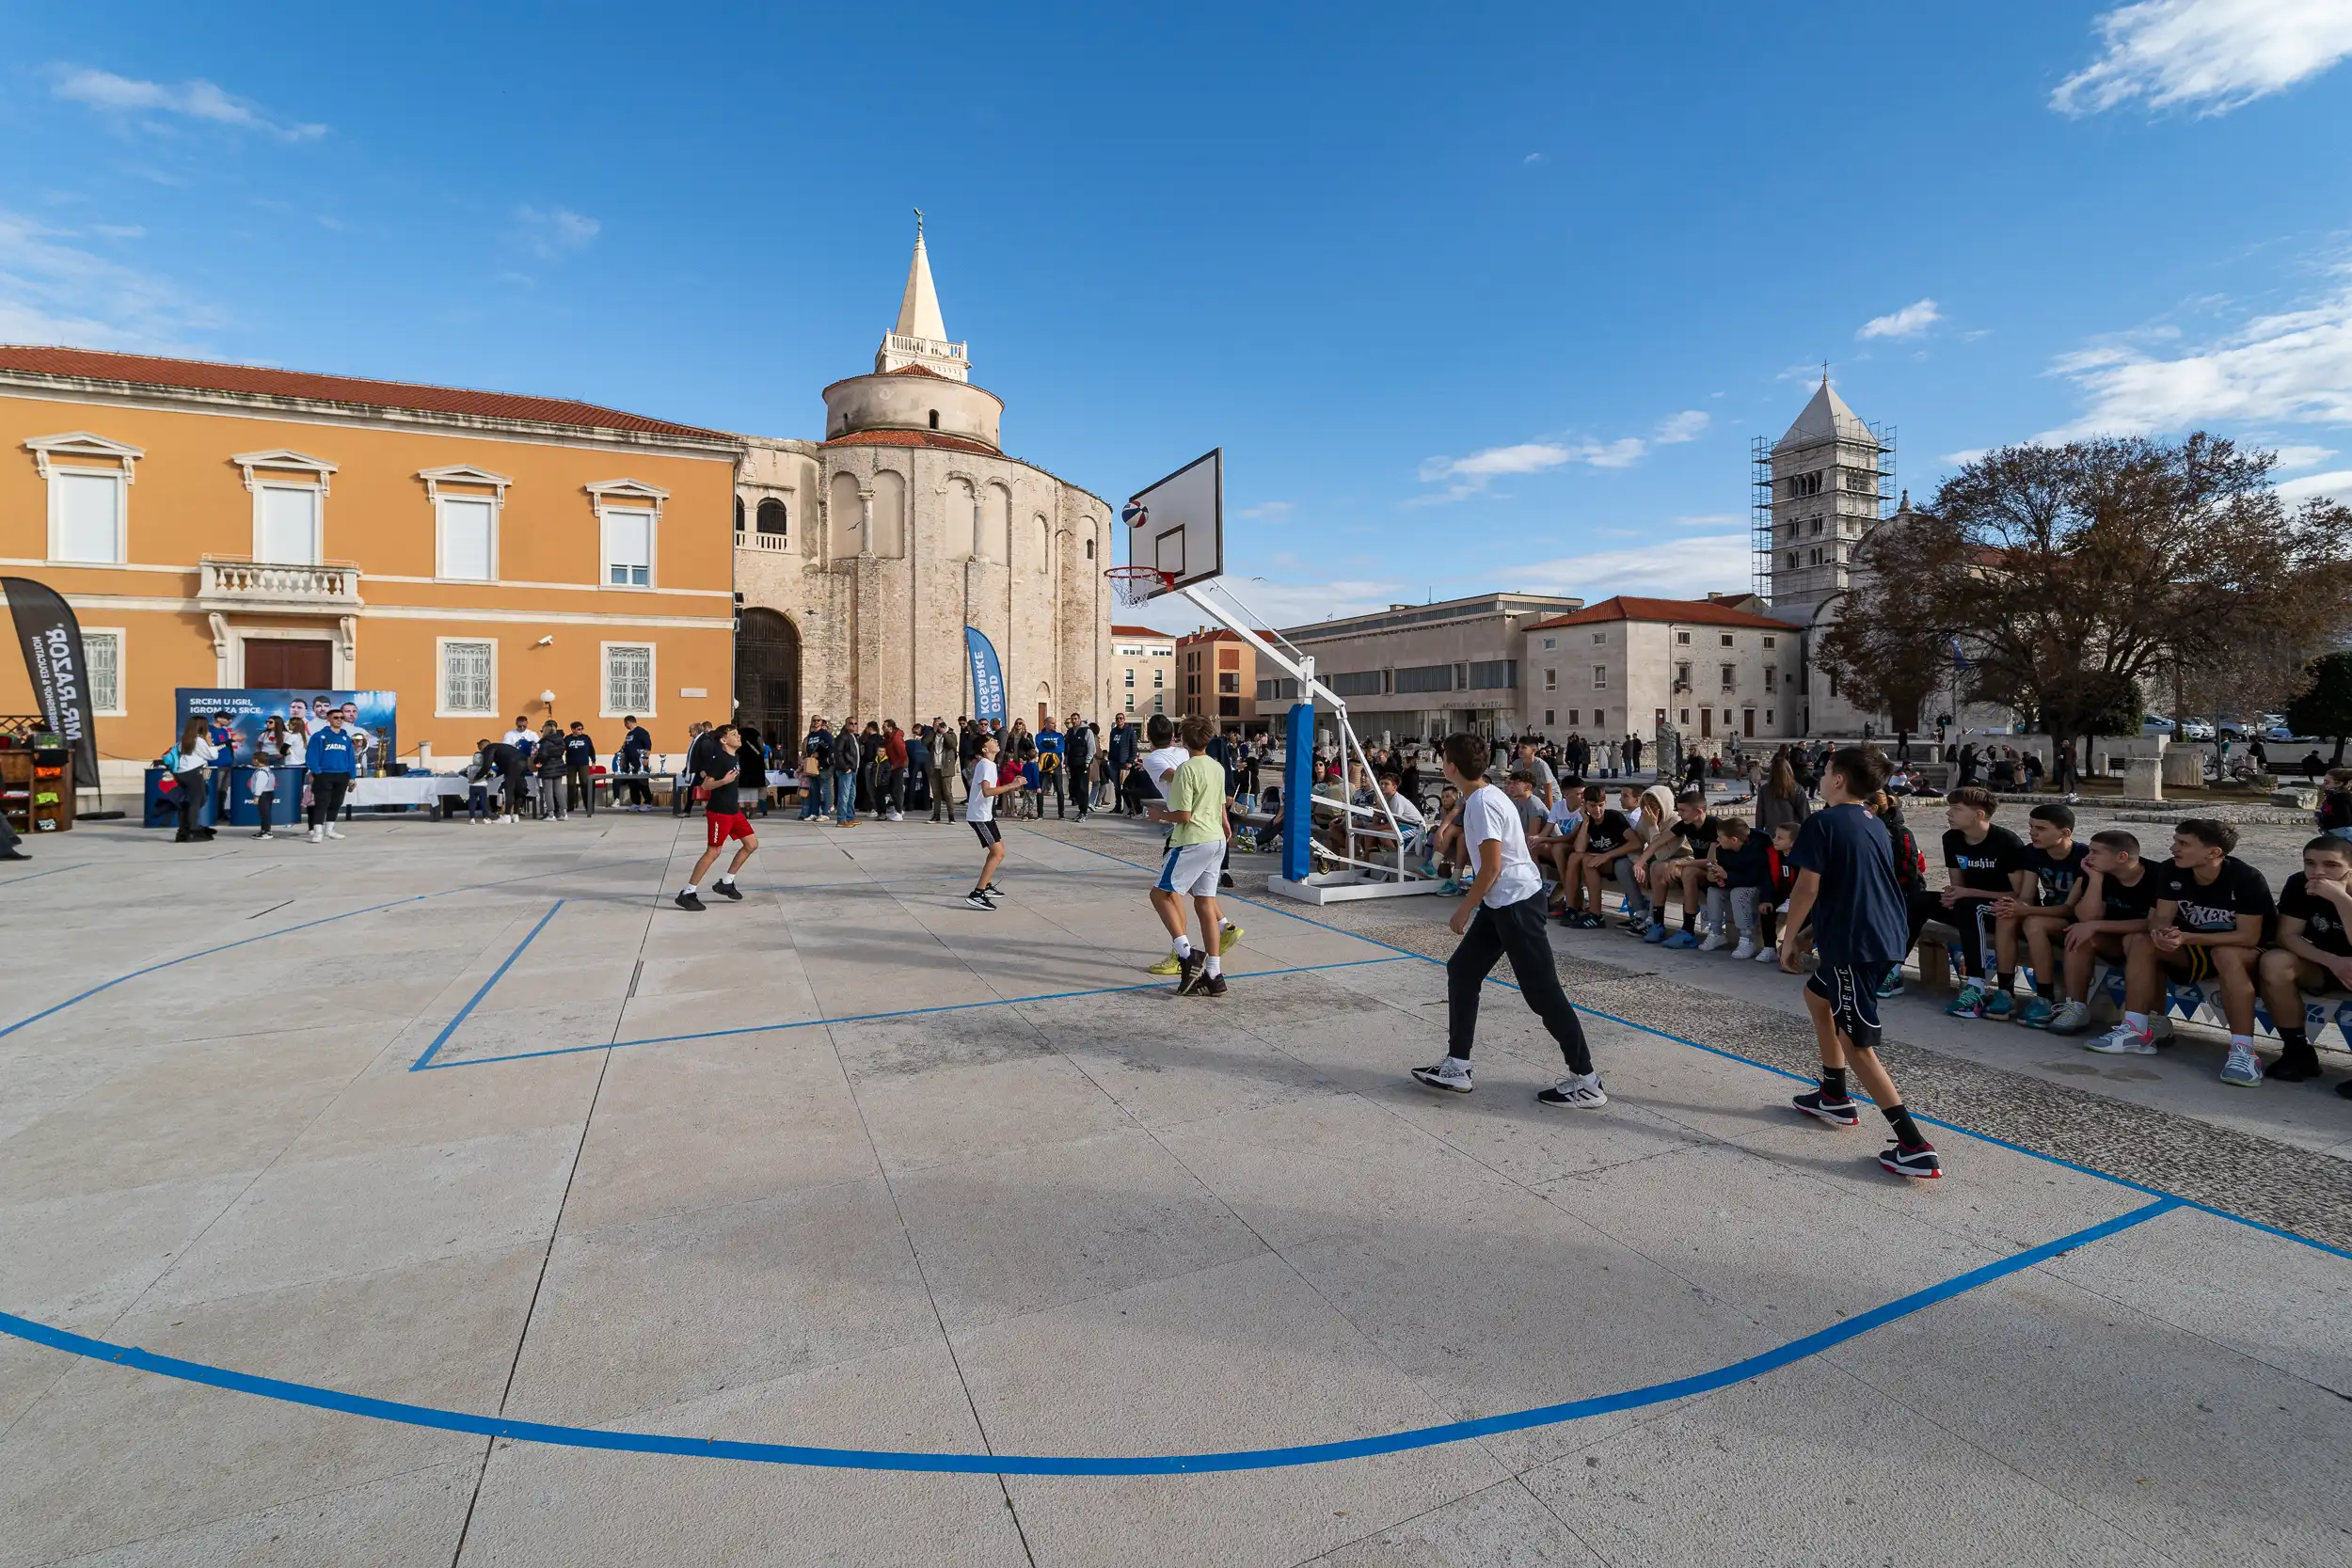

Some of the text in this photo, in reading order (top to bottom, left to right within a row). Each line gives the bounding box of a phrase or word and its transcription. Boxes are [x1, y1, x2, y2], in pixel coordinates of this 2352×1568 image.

[231, 698, 254, 706] IGRI,
[325, 743, 347, 752] ZADAR
[1440, 1070, 1465, 1079] adidas
